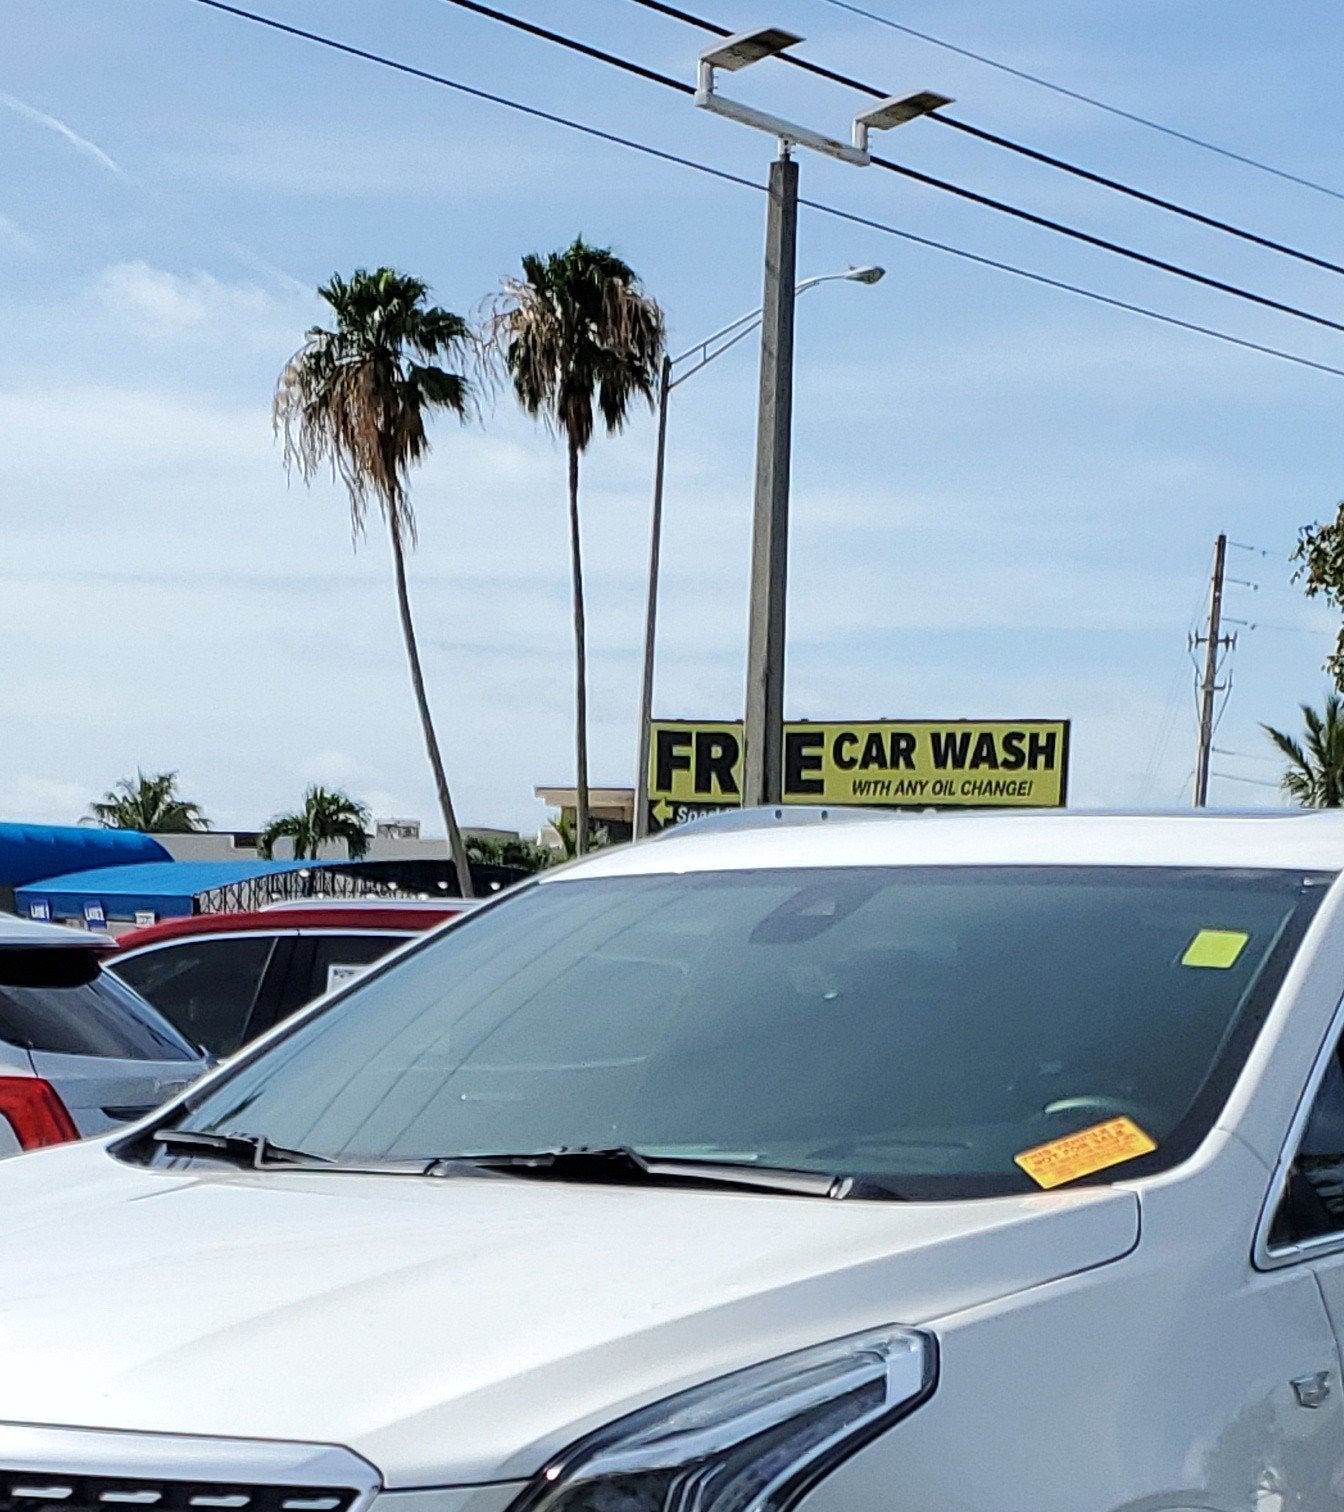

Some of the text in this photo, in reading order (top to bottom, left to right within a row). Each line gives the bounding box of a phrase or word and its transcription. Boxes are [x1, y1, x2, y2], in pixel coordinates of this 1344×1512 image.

[656, 731, 1056, 795] FRE CAR WASH
[852, 779, 1033, 797] WITH ANY OIL CHANGE!
